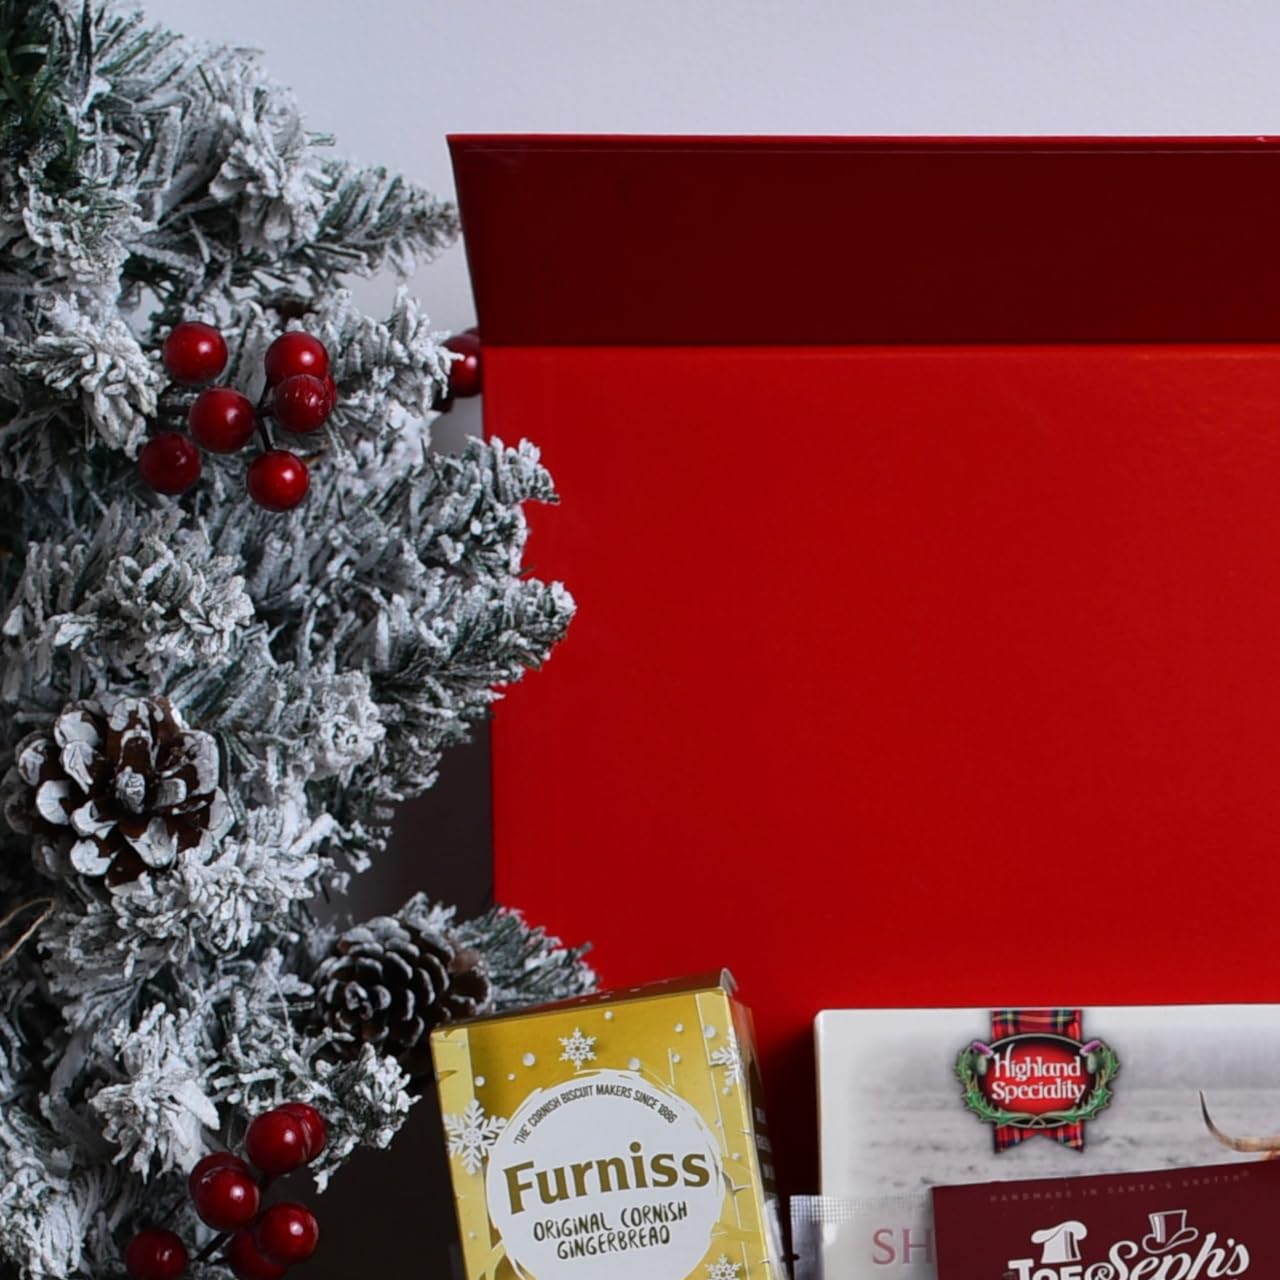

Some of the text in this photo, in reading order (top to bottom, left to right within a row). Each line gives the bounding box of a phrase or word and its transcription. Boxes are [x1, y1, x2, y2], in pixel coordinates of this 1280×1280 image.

[993, 1043, 1082, 1082] Highland
[527, 1096, 561, 1128] CORNISH
[560, 1084, 594, 1104] BISCUIT
[595, 1083, 633, 1098] MAKERS
[632, 1089, 660, 1110] SINCE
[657, 1103, 679, 1124] 1886
[991, 1077, 1087, 1104] Speciality
[502, 1141, 710, 1216] Furniss
[533, 1200, 688, 1242] ORIGINAL CORNISH
[556, 1224, 671, 1260] GINGERBREAD
